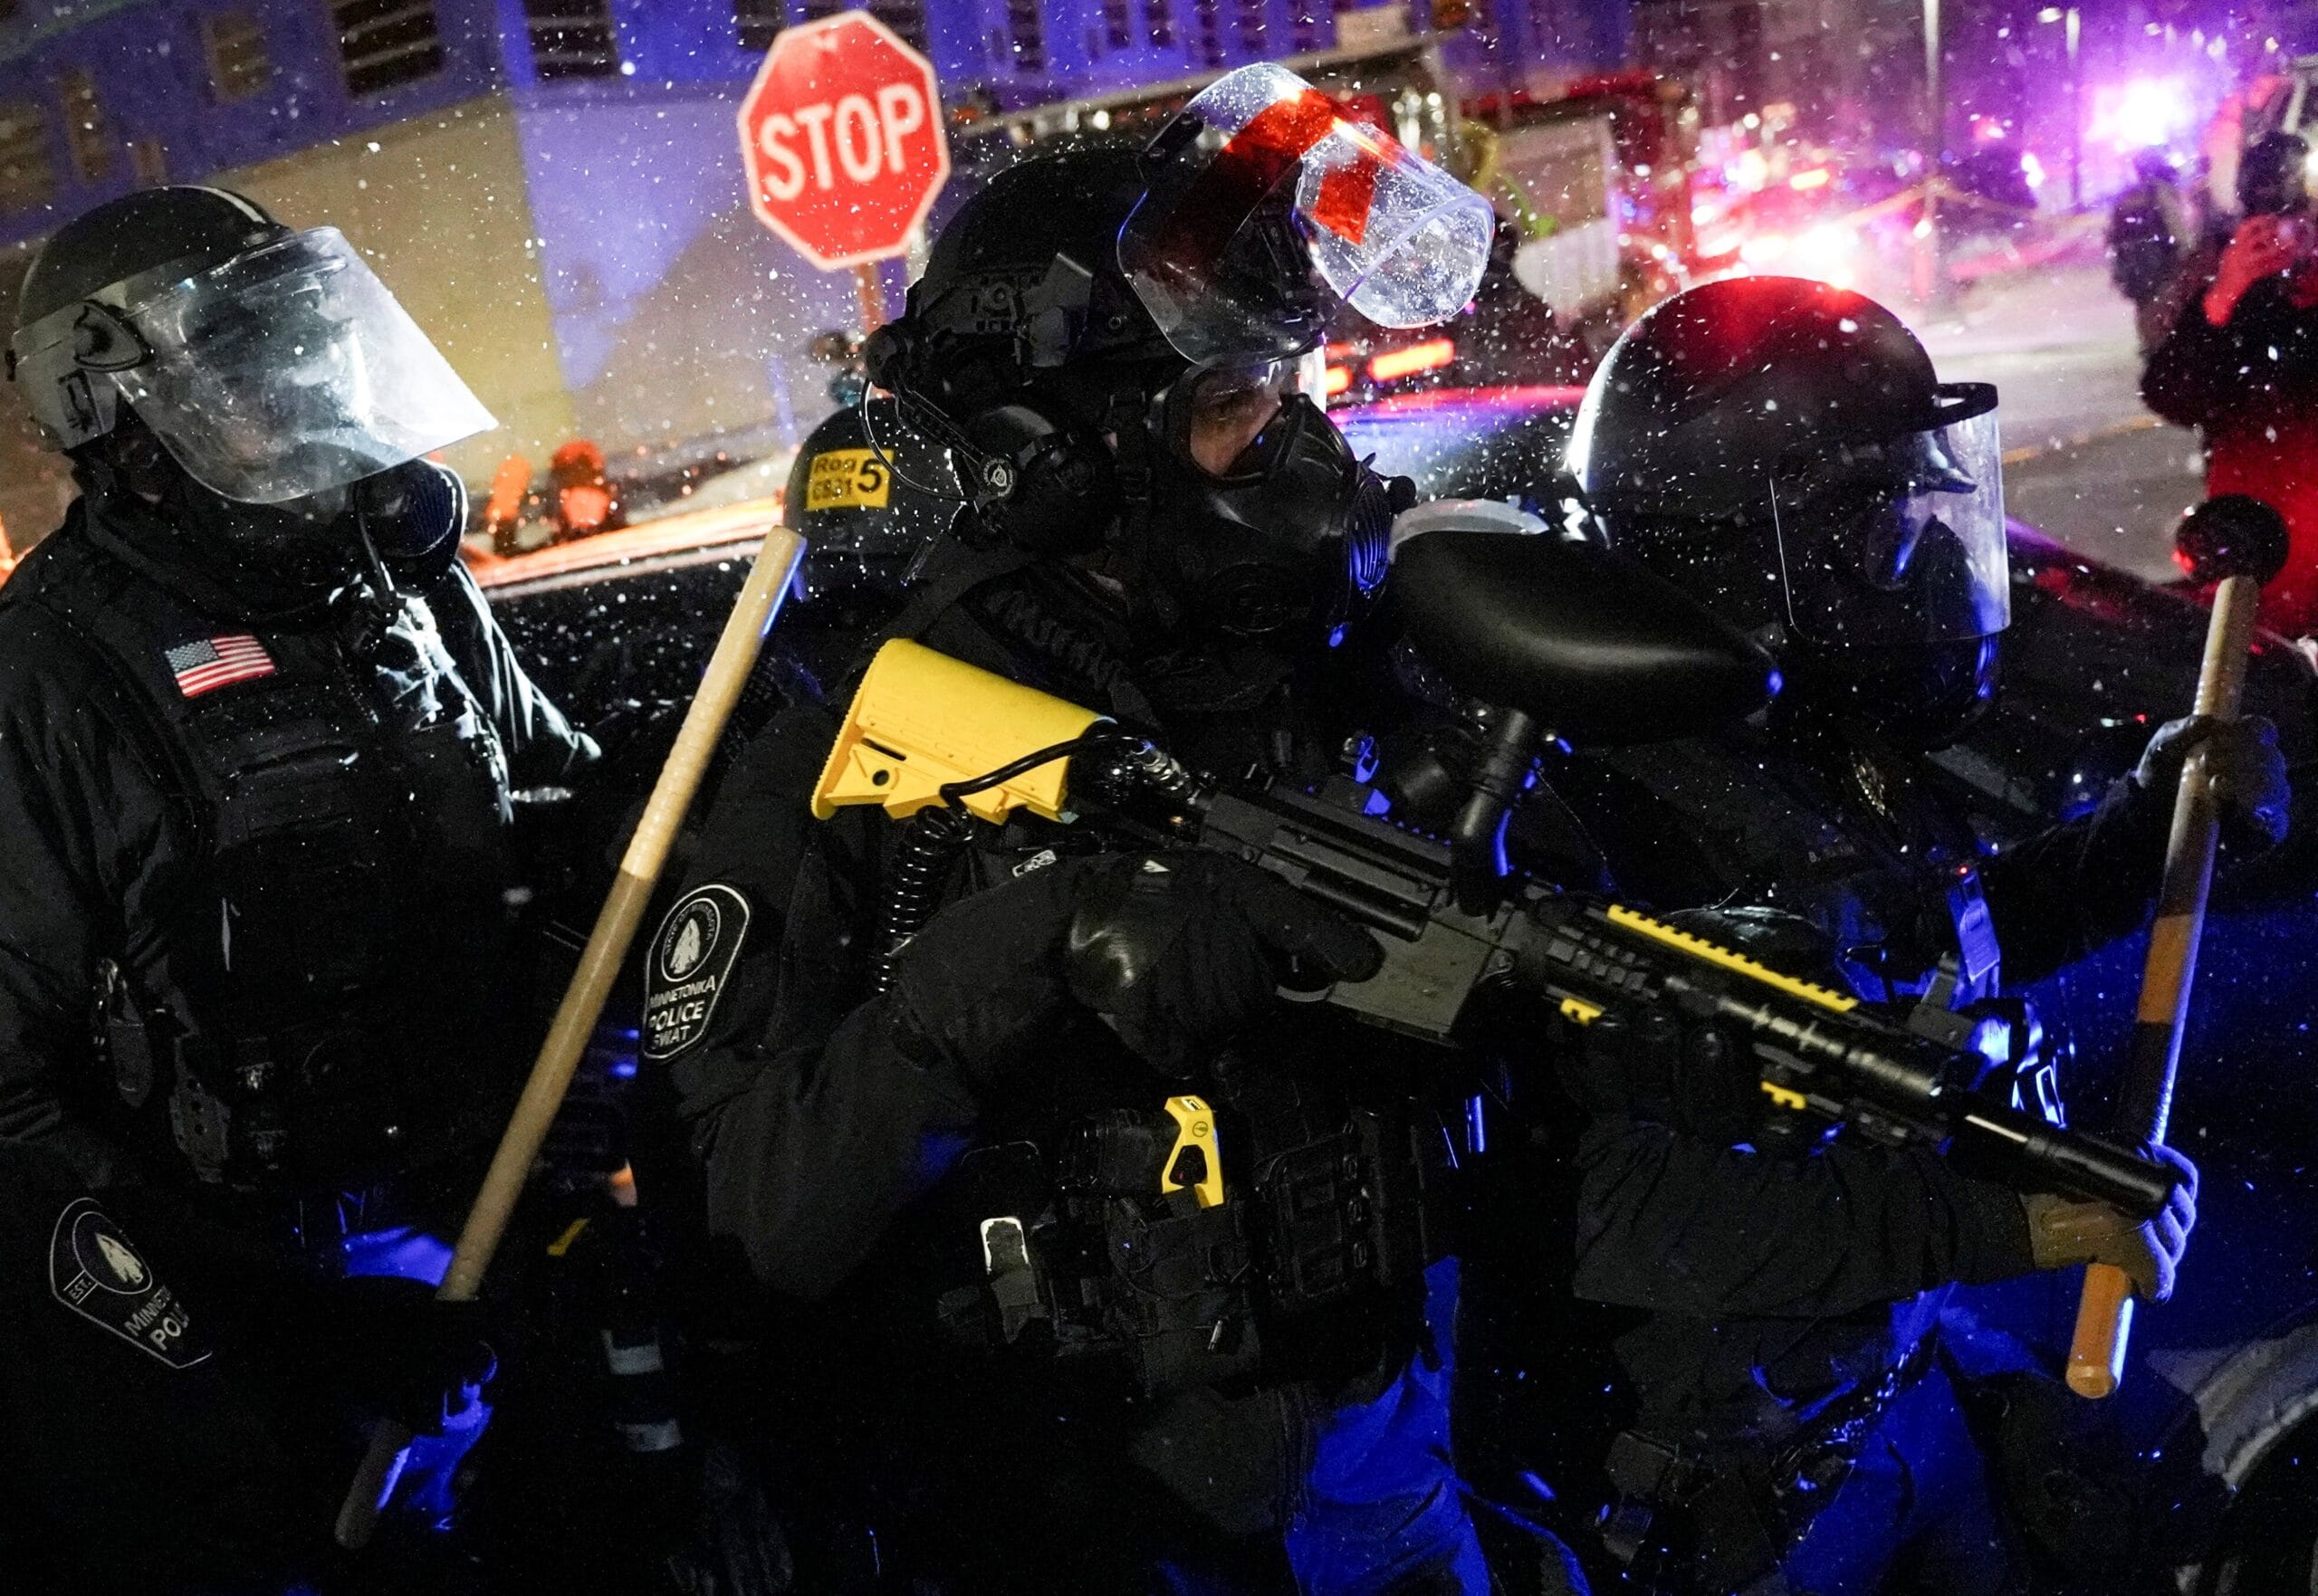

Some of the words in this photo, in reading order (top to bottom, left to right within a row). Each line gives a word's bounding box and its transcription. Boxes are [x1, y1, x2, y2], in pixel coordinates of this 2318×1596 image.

[760, 83, 924, 201] STOP
[857, 459, 883, 493] 5
[648, 999, 705, 1031] POLICE
[652, 1025, 691, 1050] SWAT
